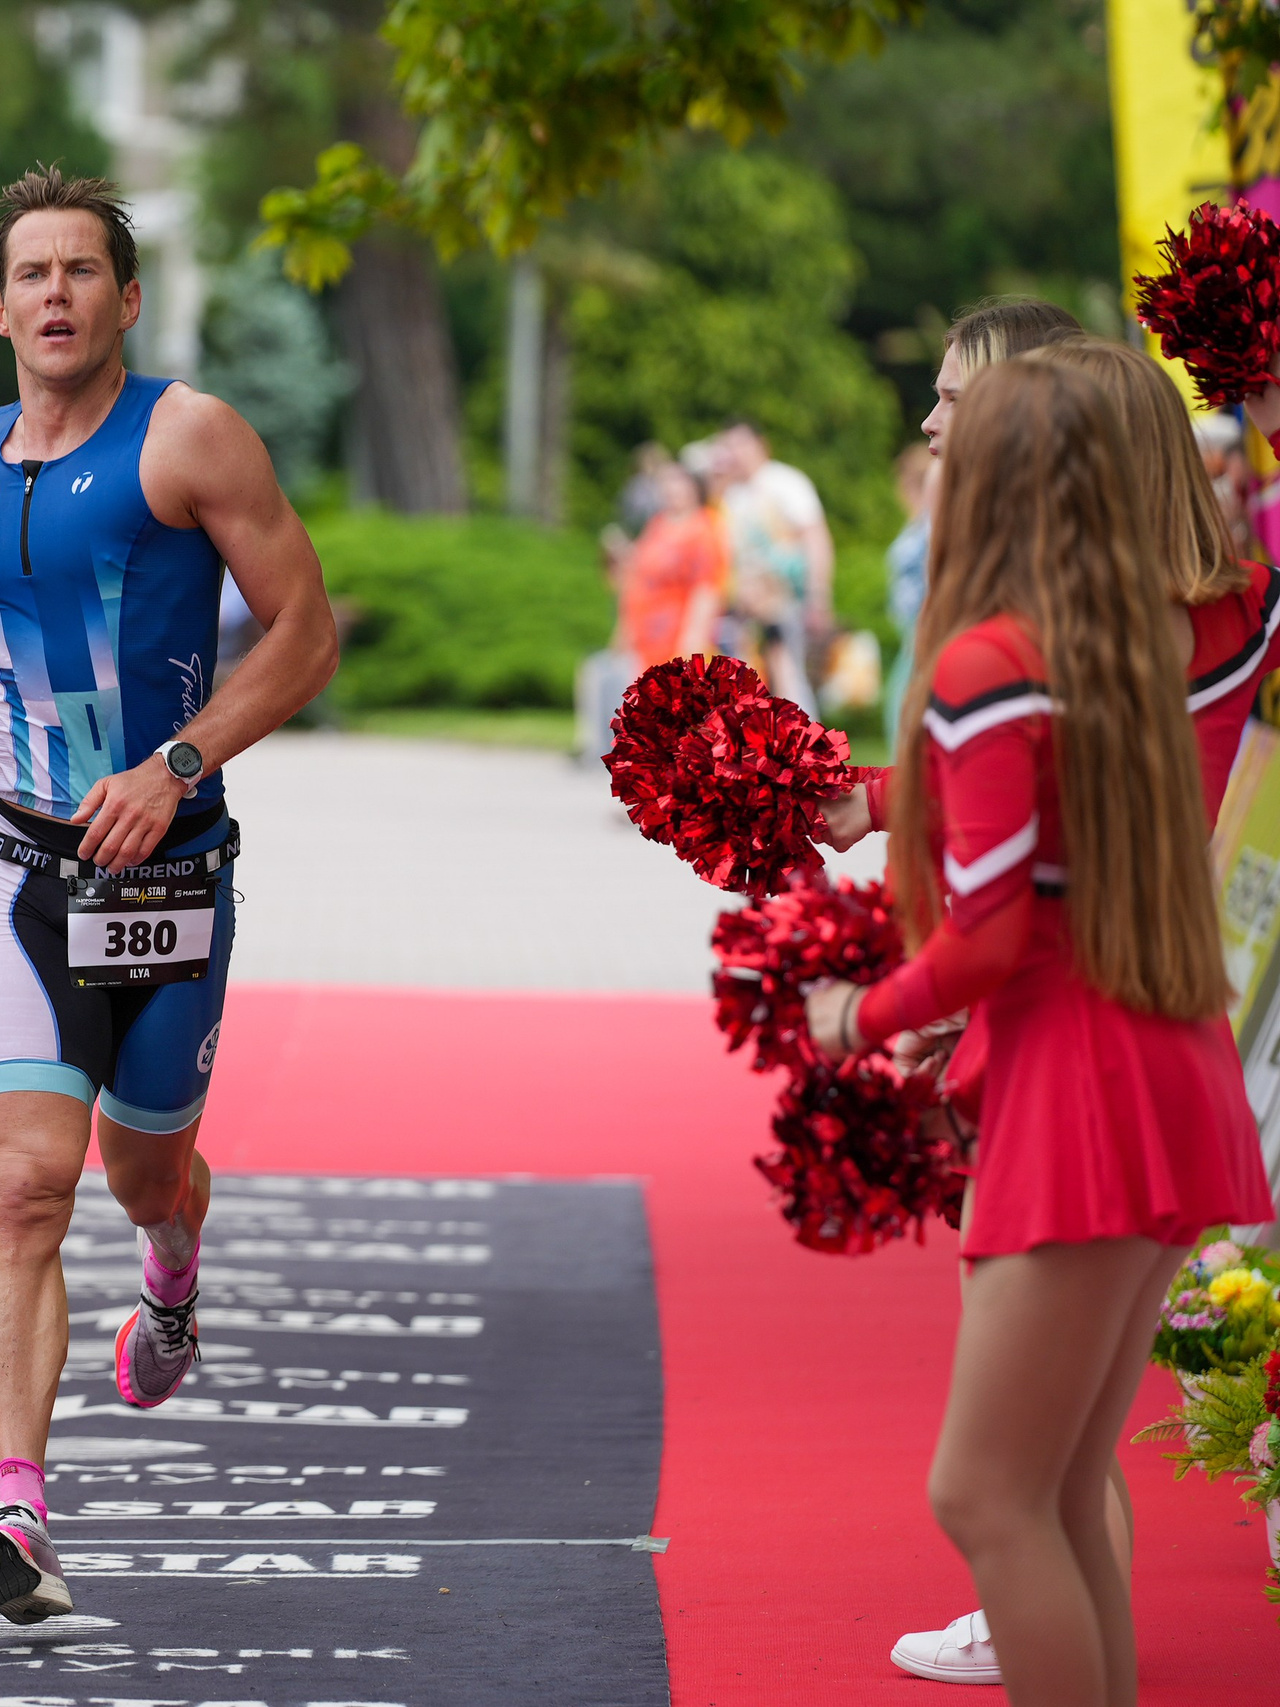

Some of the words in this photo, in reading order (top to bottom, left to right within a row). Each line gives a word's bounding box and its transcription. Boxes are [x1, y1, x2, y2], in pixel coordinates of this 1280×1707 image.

[121, 887, 140, 898] IRON
[147, 886, 167, 897] STAR
[105, 920, 178, 958] 380
[130, 968, 151, 979] ILYA
[151, 1396, 470, 1423] STAR
[77, 1499, 439, 1517] STAR
[61, 1552, 423, 1573] STAR
